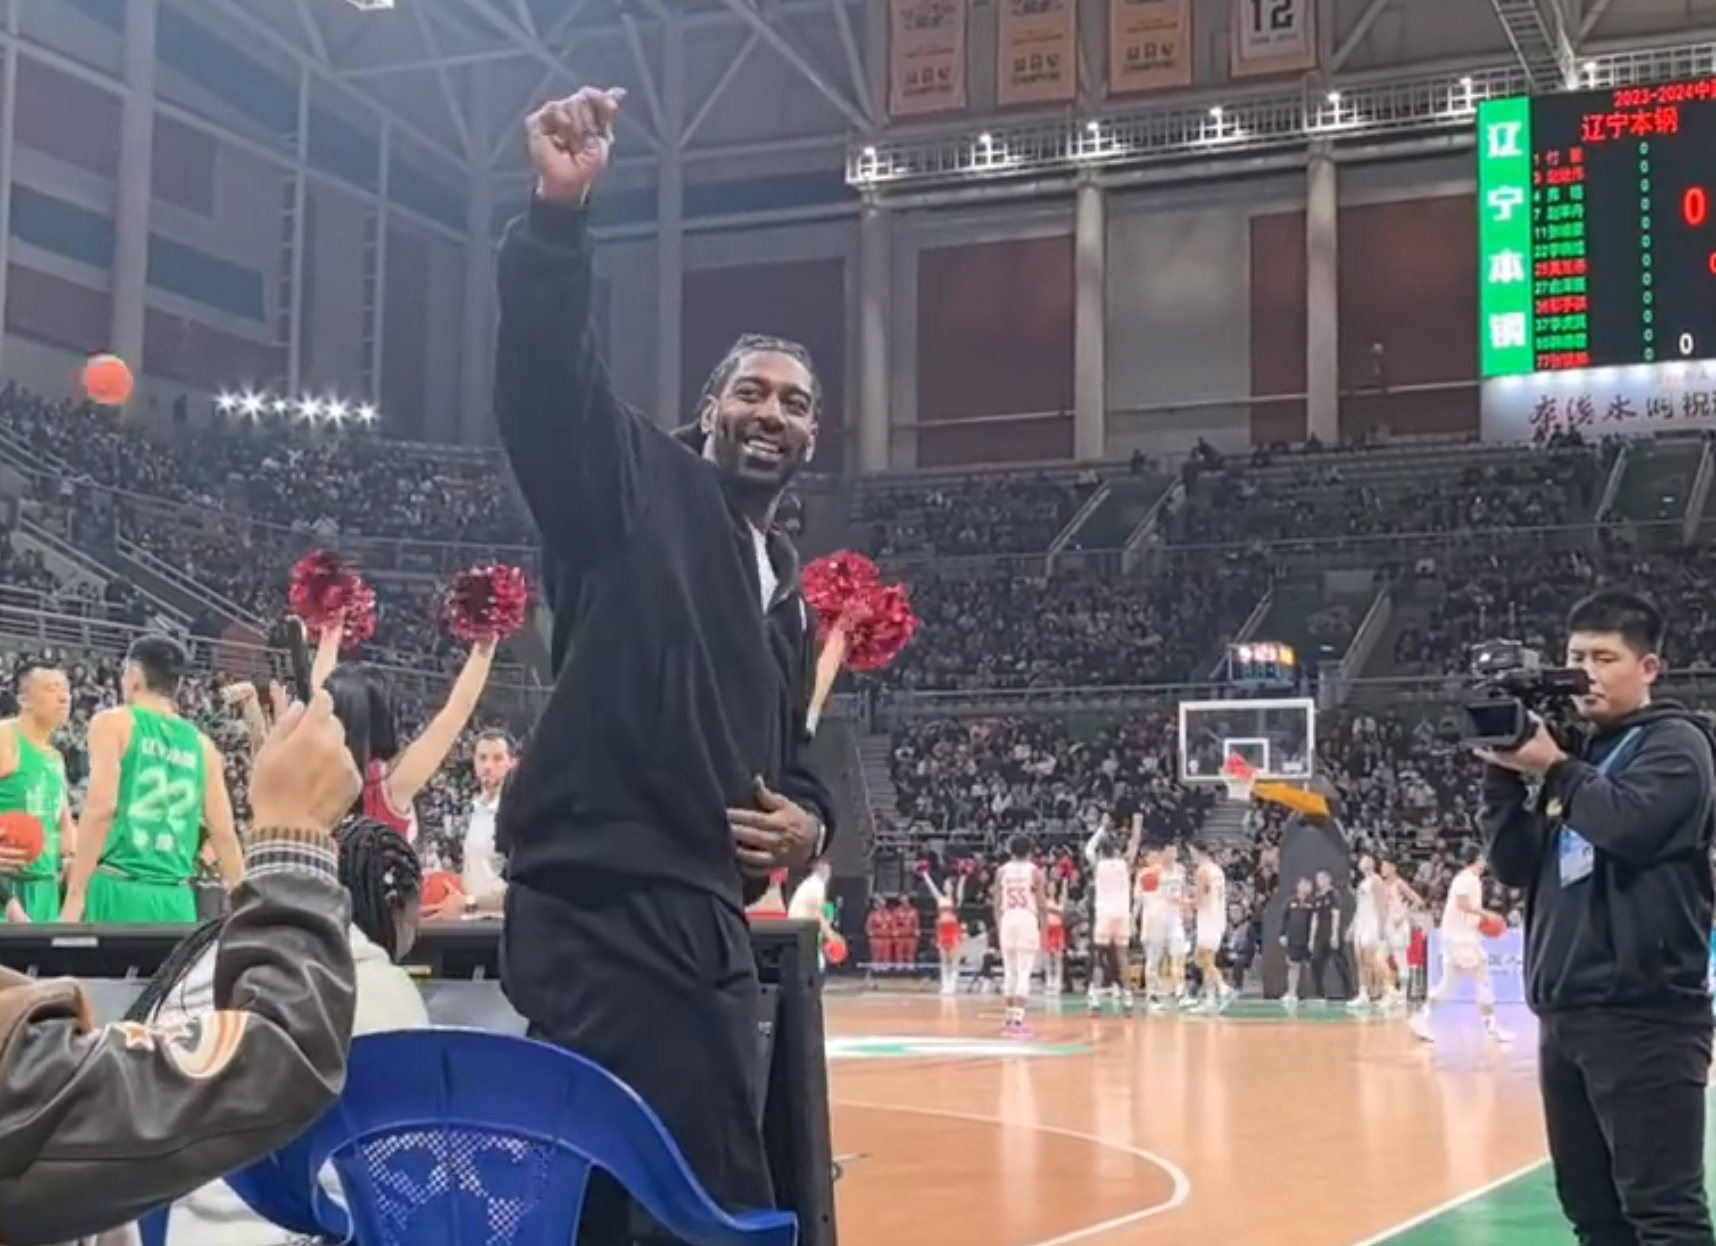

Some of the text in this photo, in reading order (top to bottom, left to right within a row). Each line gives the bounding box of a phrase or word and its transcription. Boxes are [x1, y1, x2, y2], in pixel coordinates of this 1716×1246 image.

[1252, 0, 1295, 32] 12
[1581, 107, 1678, 142] 辽宁本钢
[1684, 187, 1706, 225] 0
[1486, 120, 1527, 348] 辽宁本钢
[1679, 333, 1694, 355] 0
[128, 767, 196, 831] 22
[1006, 887, 1027, 909] 55
